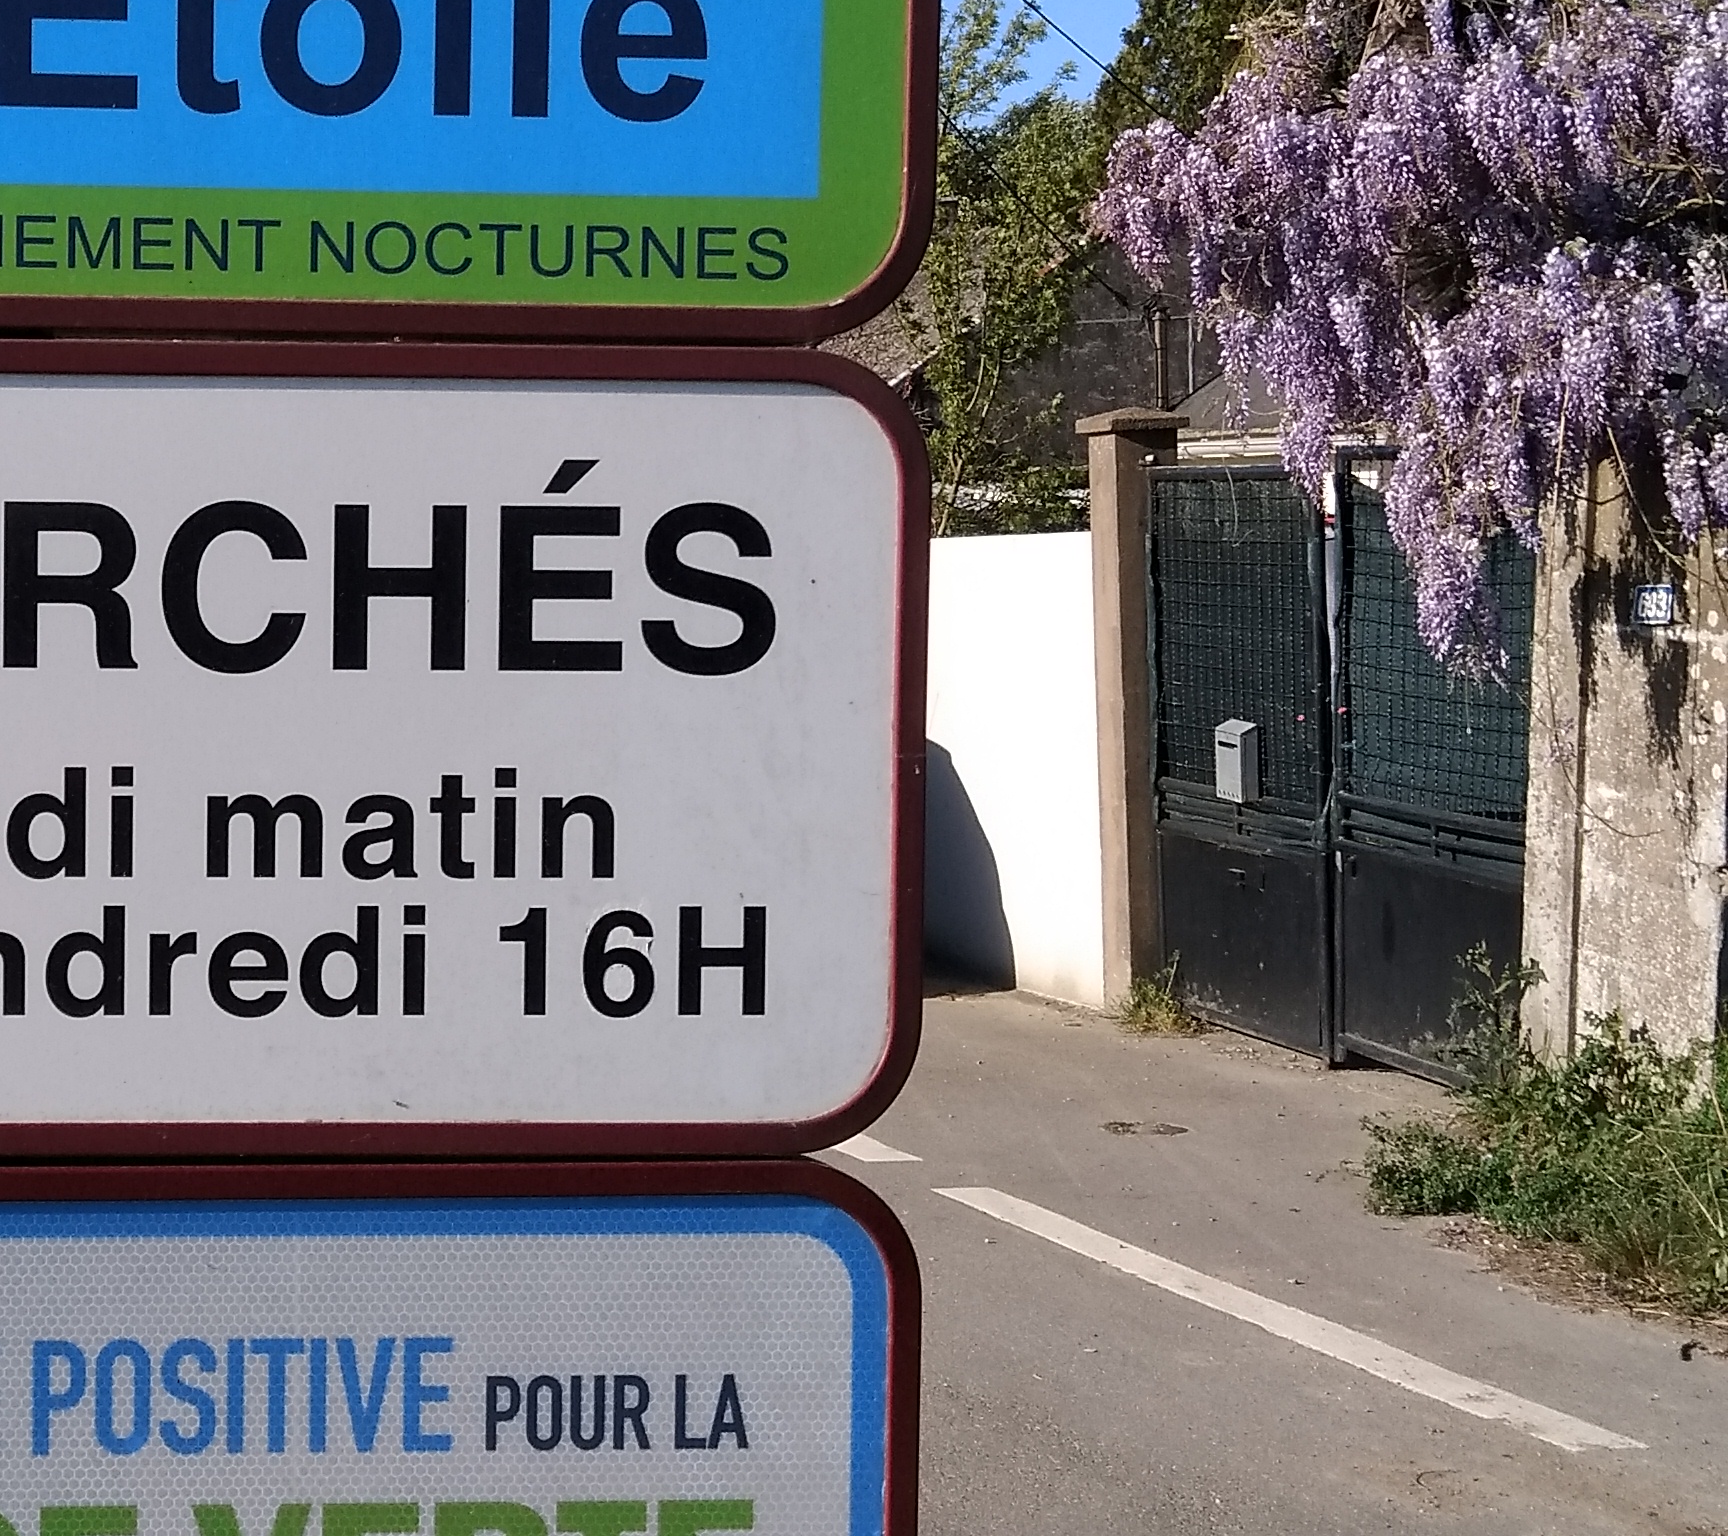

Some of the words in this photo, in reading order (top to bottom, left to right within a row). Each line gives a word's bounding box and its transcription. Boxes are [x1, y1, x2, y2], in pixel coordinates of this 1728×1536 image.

[309, 221, 789, 281] NOCTURNES
[207, 768, 614, 879] matin
[499, 906, 766, 1019] 16H
[32, 1337, 453, 1457] POSITIVE
[486, 1374, 650, 1451] POUR
[674, 1374, 748, 1449] LA
